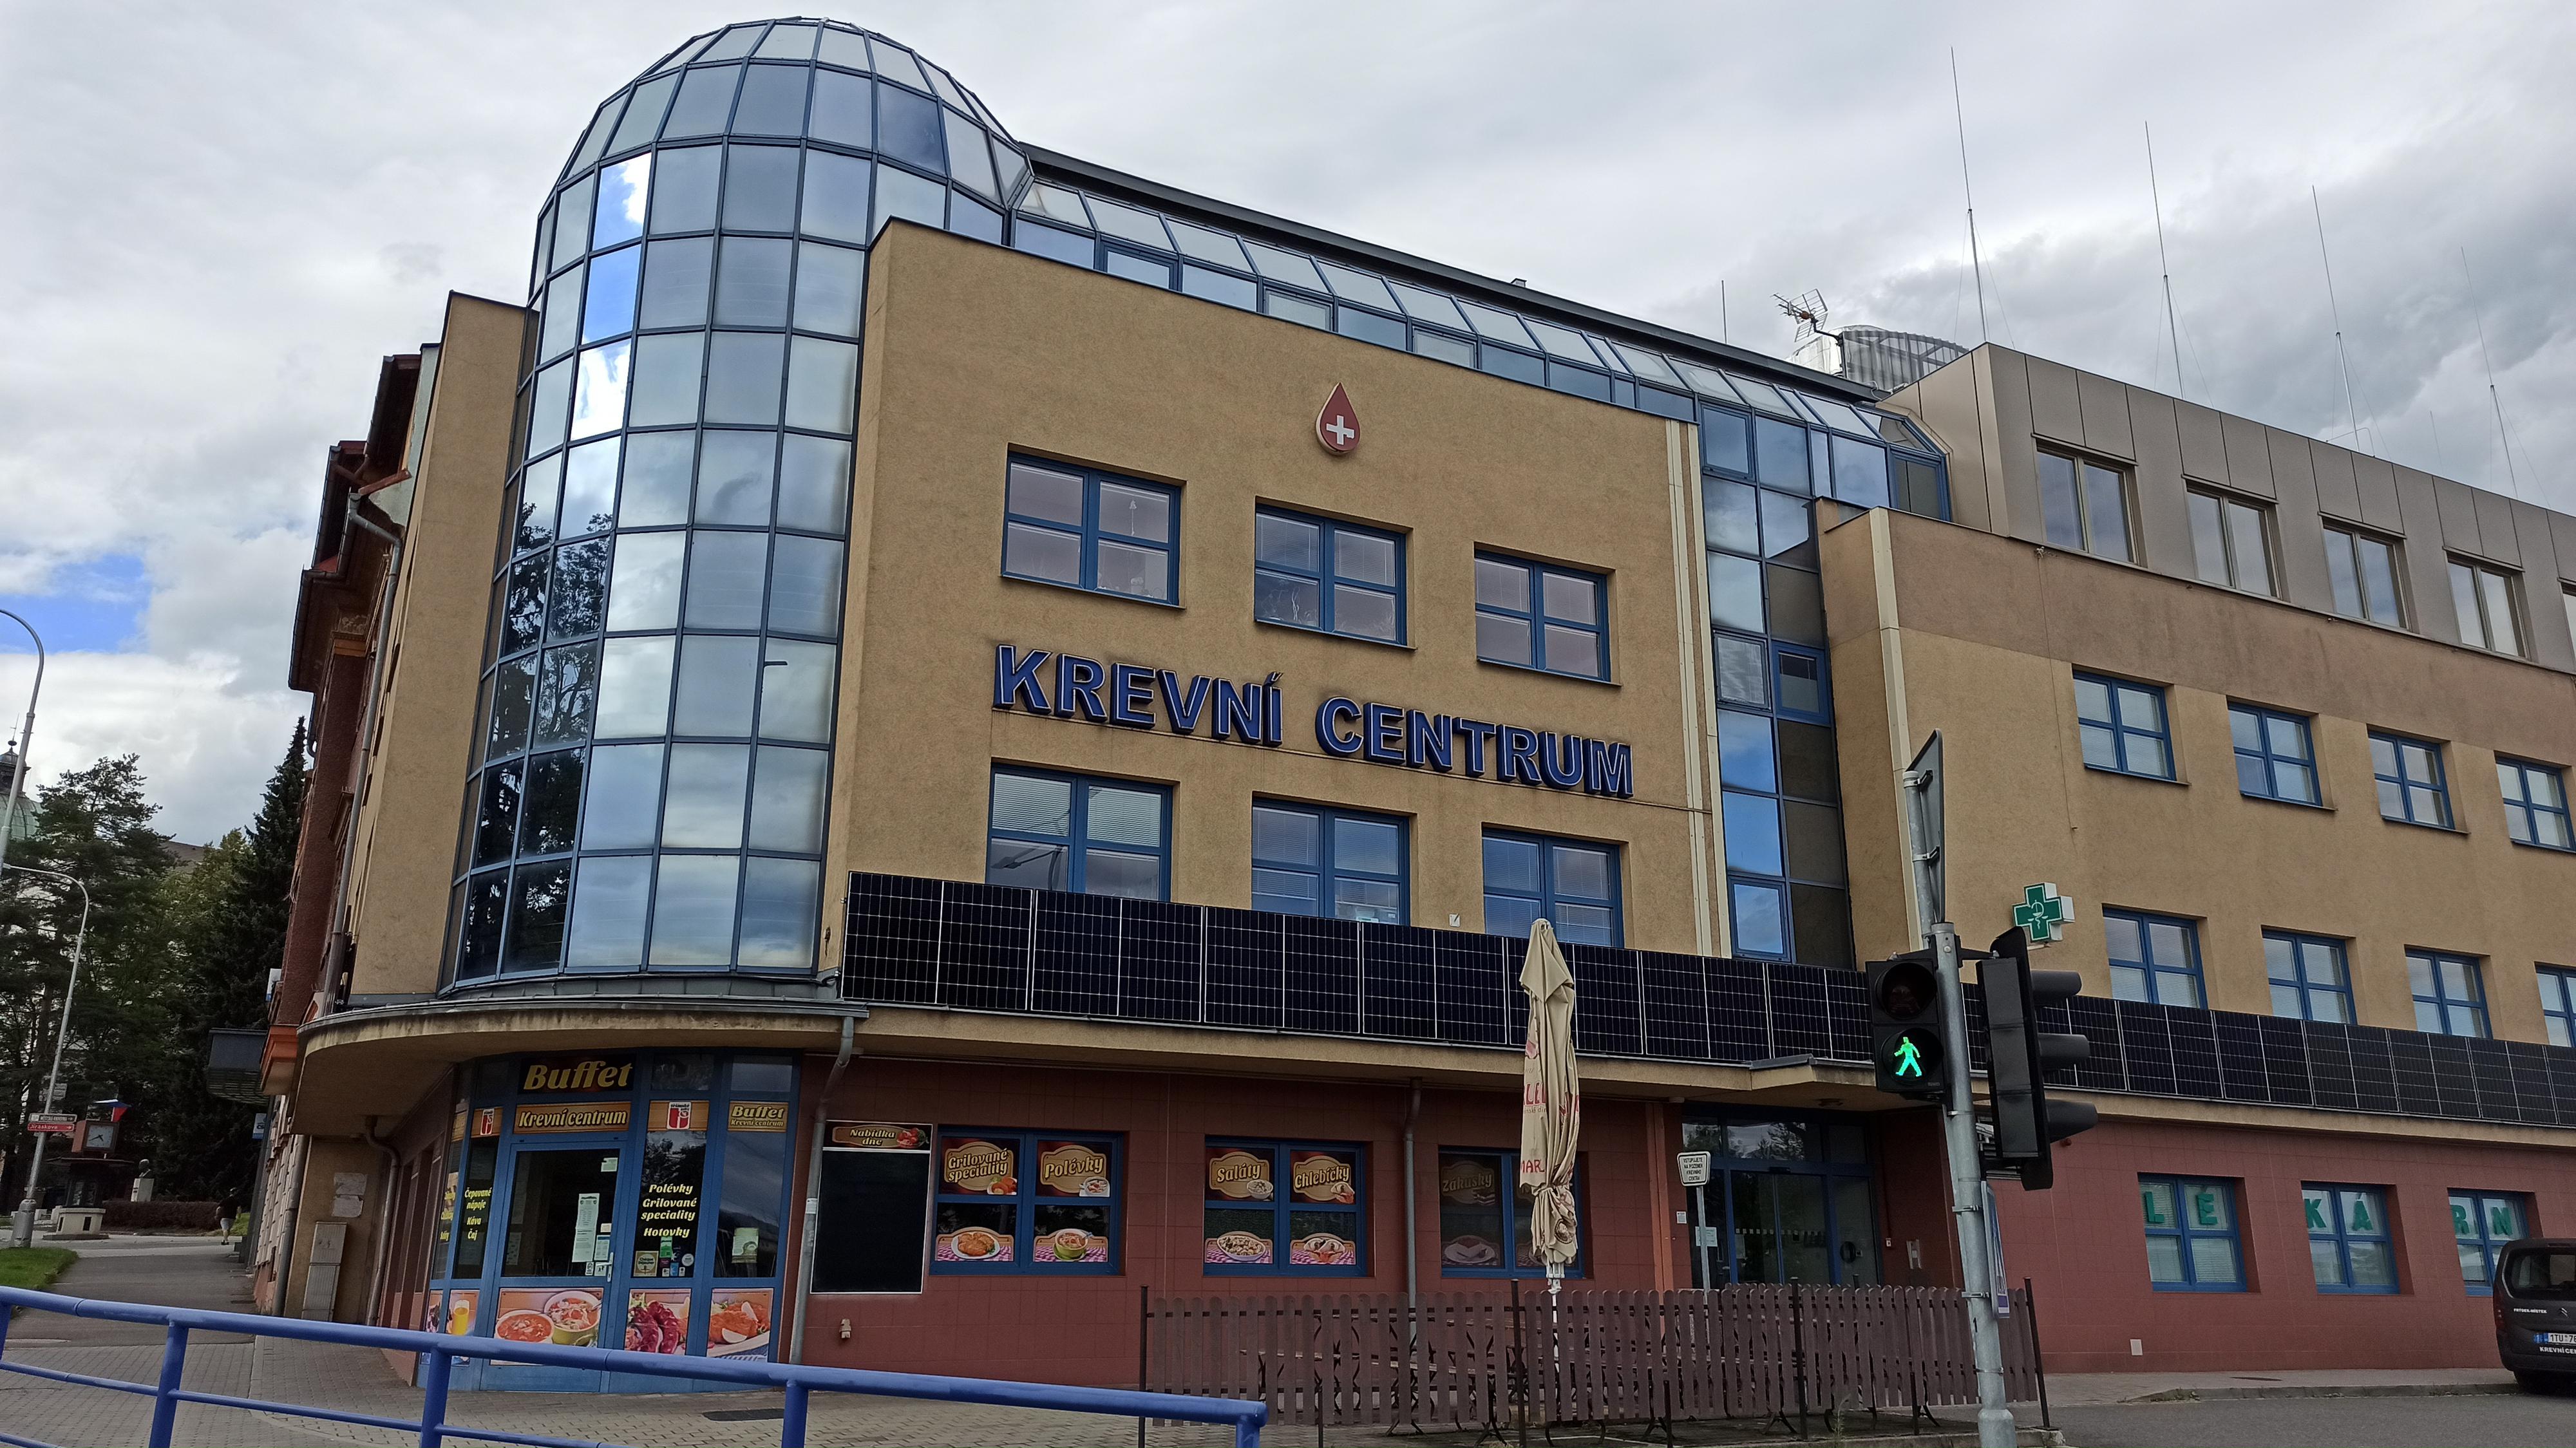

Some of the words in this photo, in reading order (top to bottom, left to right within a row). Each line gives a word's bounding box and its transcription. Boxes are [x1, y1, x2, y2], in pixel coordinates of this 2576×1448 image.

[994, 644, 1283, 748] KREVNÍ
[1315, 696, 1634, 798] CENTRUM
[523, 1060, 632, 1090] Buffet
[518, 1109, 569, 1127] Krevní
[567, 1109, 627, 1125] centrum
[732, 1105, 785, 1118] Buffet
[731, 1118, 755, 1126] Krevní
[850, 1128, 896, 1138] Nabídka
[948, 1148, 1008, 1170] Grilované
[948, 1162, 1008, 1183] speciality
[1044, 1157, 1103, 1179] Polévky
[1217, 1163, 1261, 1183] Saláty
[1294, 1165, 1350, 1189] Chlebíčky
[464, 1187, 492, 1199] Čepované
[649, 1183, 694, 1195] Polévky
[466, 1199, 486, 1211] nápoje
[642, 1198, 697, 1208] Grilované
[466, 1216, 482, 1225] Káva
[641, 1210, 696, 1222] speciality
[468, 1228, 478, 1241] Čaj
[643, 1227, 690, 1238] Hotovky
